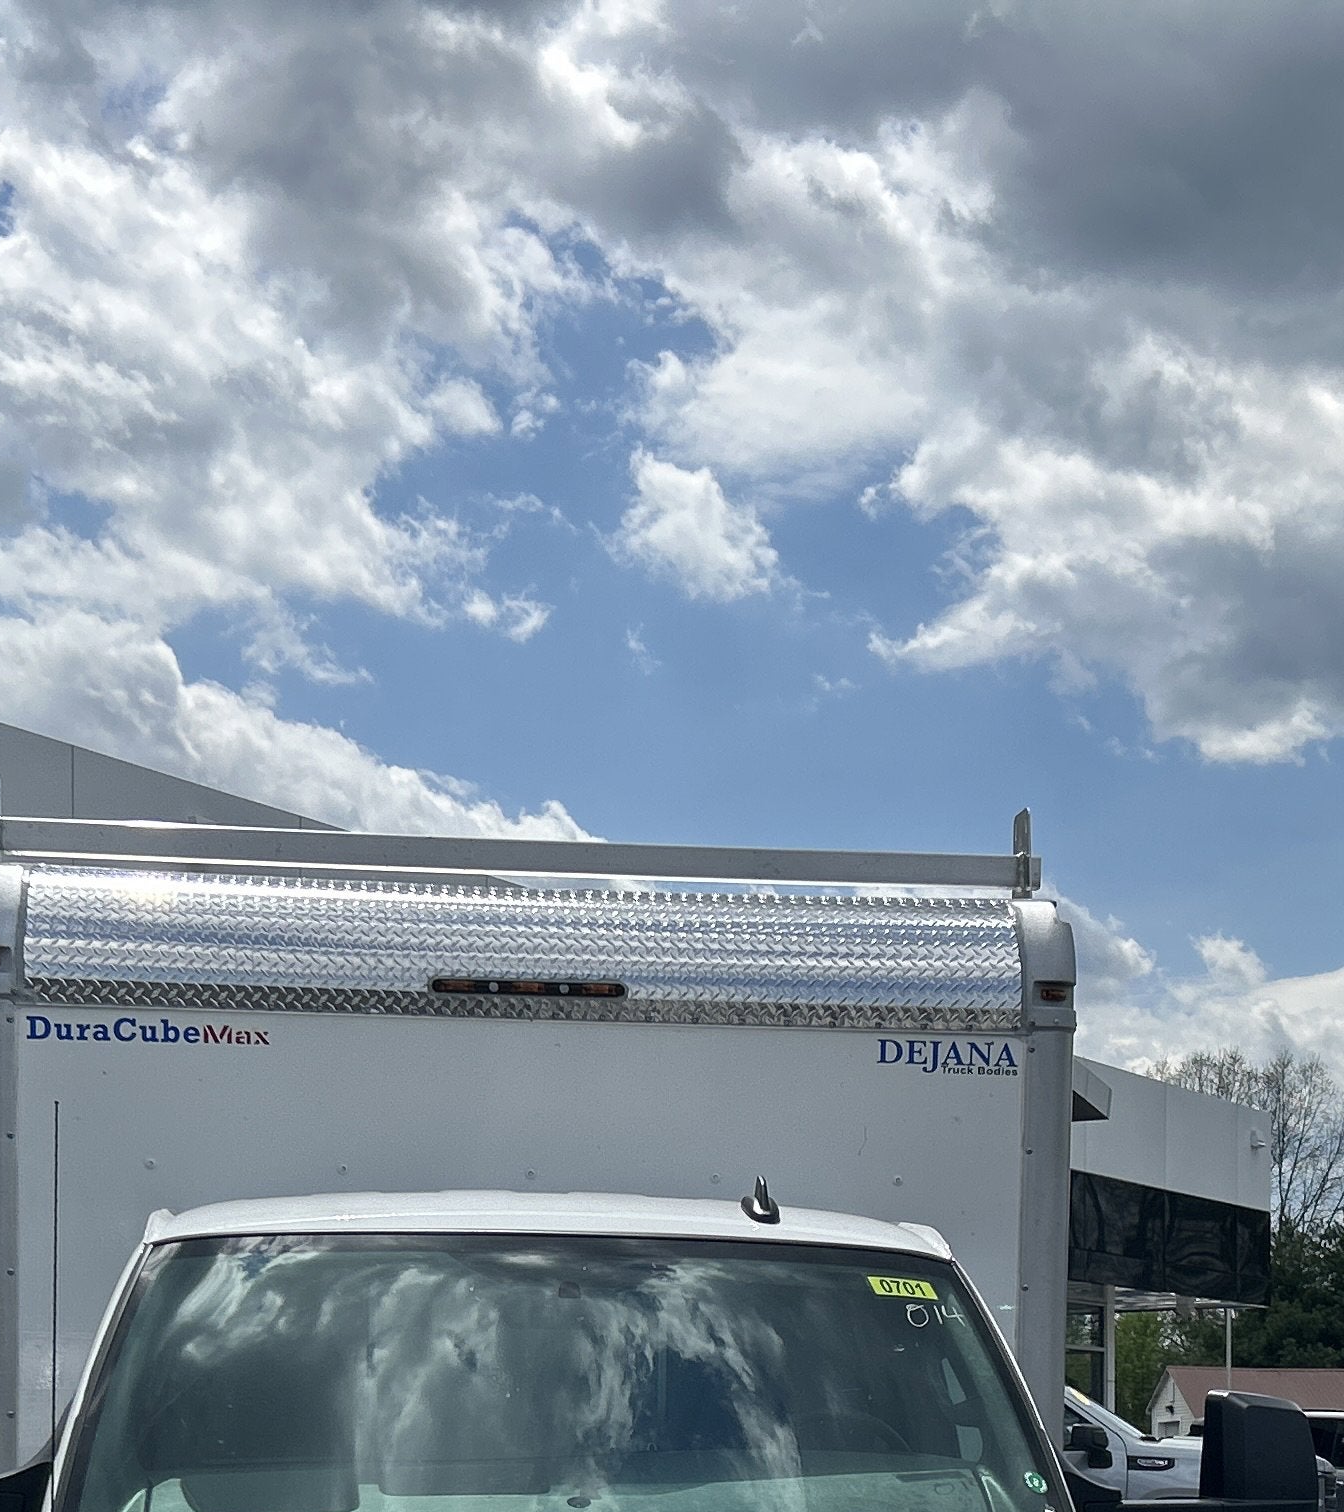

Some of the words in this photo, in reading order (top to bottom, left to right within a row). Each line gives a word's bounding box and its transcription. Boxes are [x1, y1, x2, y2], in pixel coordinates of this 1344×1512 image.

[26, 1015, 270, 1045] DuraCubeMax
[876, 1038, 1018, 1073] DEJANA
[941, 1065, 974, 1075] Truck
[977, 1066, 1018, 1077] Bodies
[879, 1278, 927, 1297] 0701
